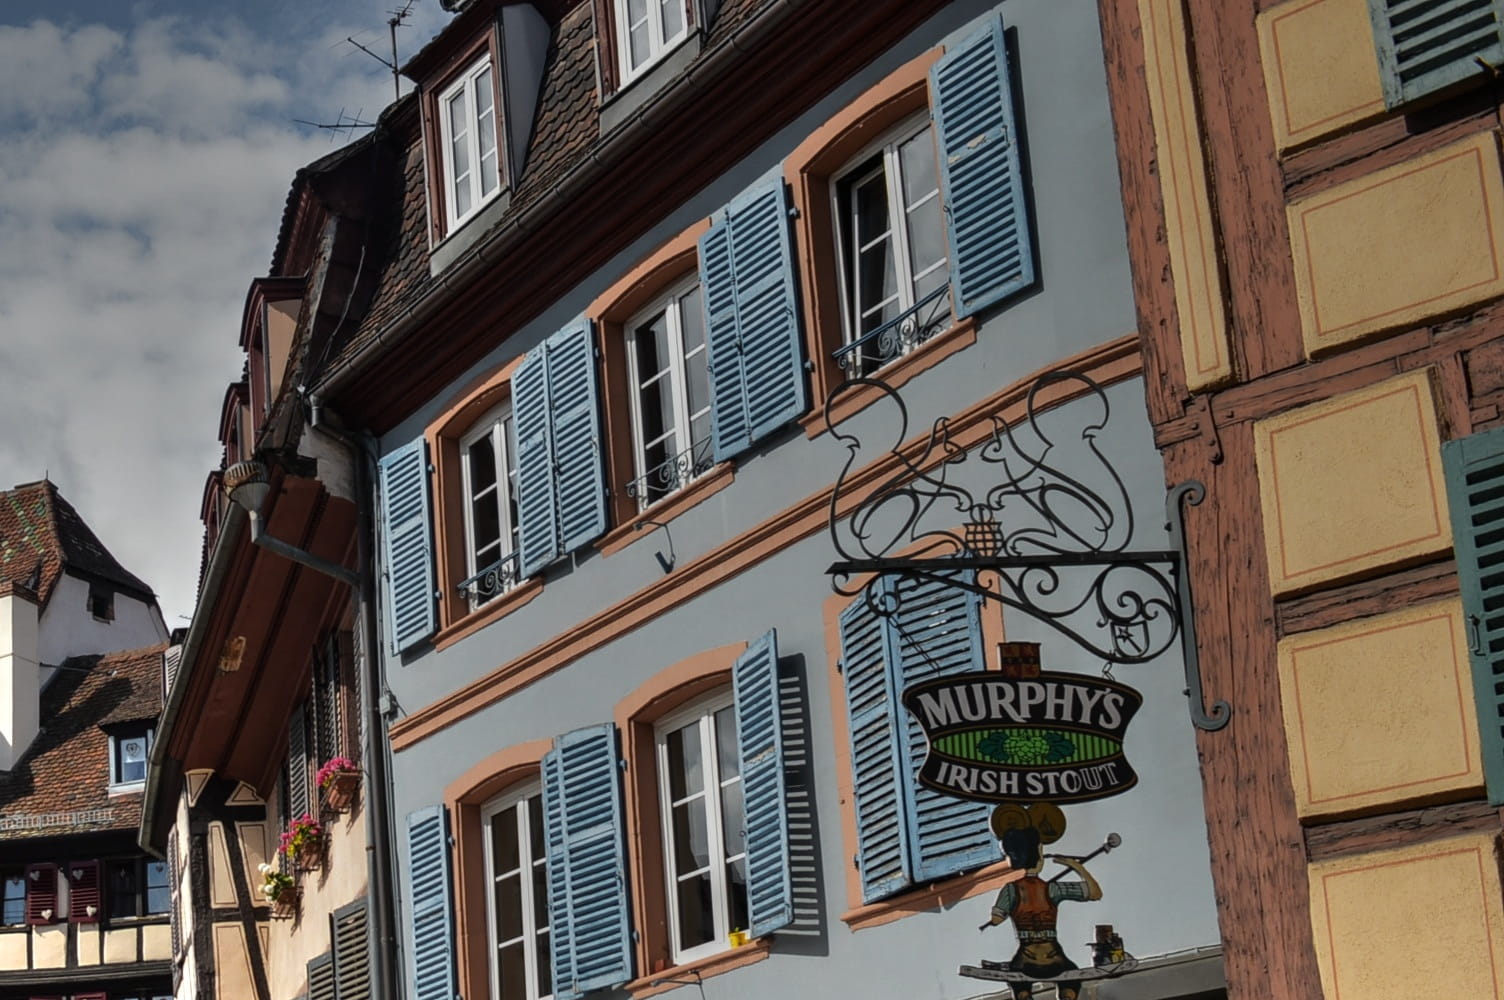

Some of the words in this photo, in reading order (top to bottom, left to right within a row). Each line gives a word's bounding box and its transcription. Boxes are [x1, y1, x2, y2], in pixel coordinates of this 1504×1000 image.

[916, 680, 1125, 730] MURPHY'S
[936, 761, 1021, 795] IRISH
[1026, 763, 1118, 796] STOUT
